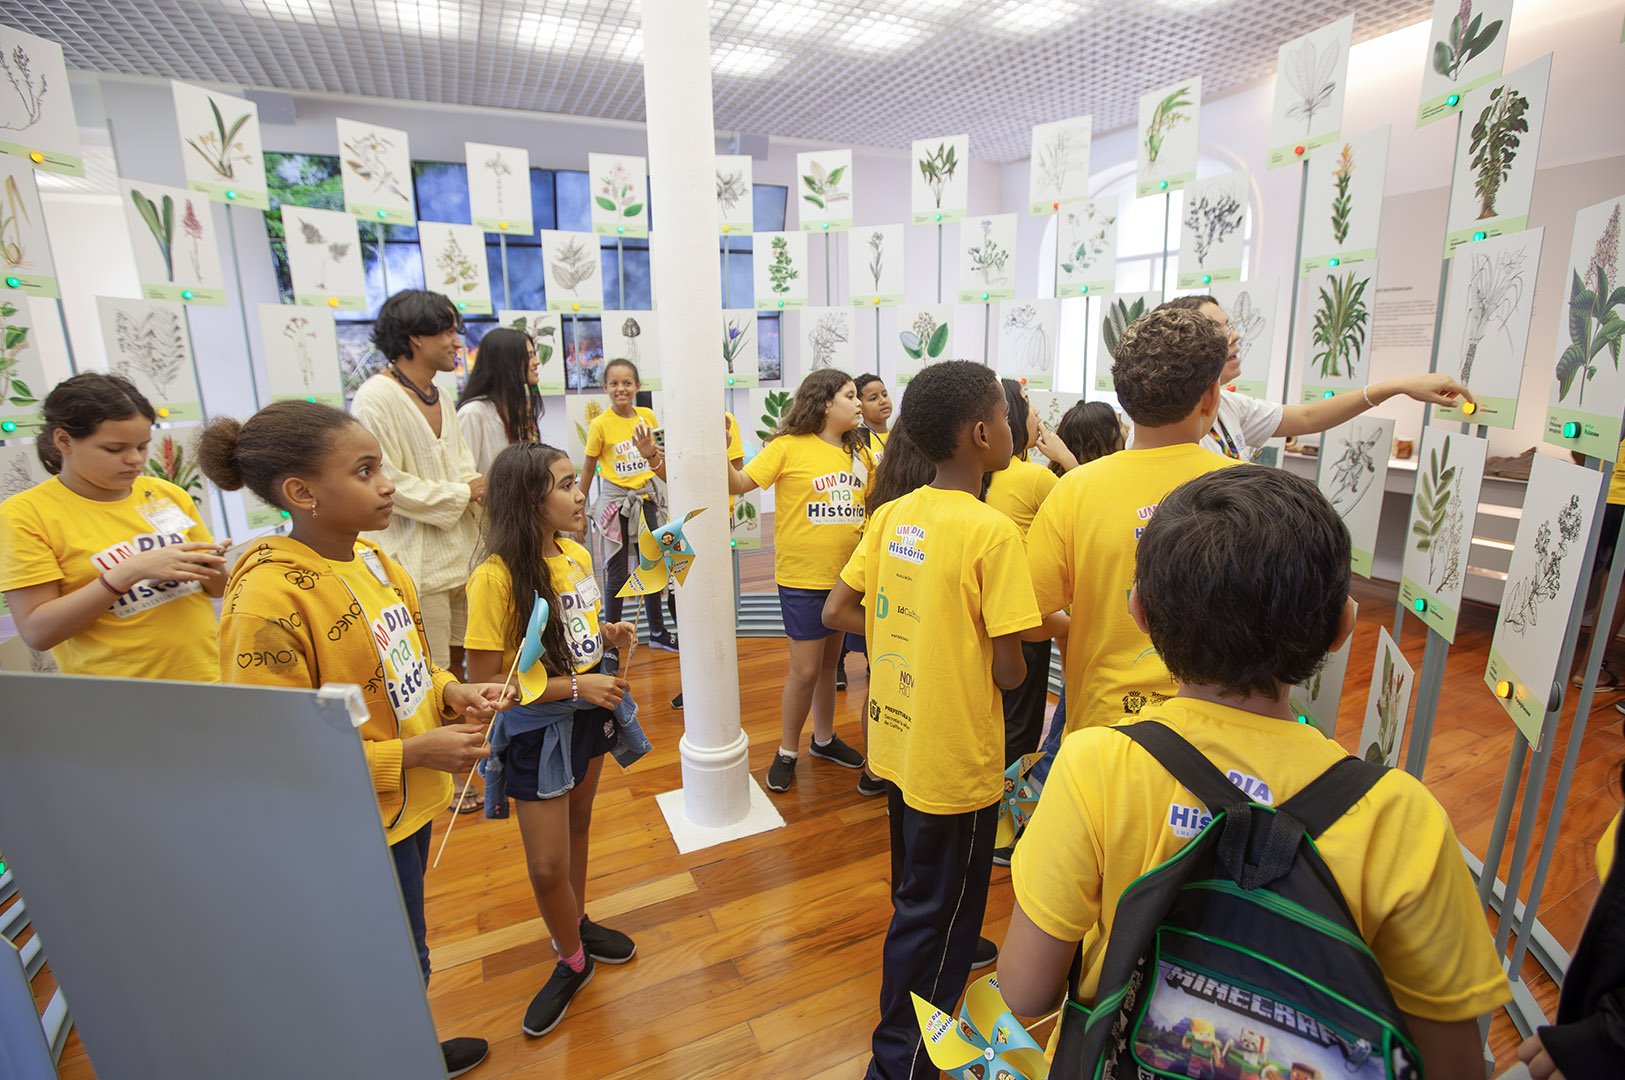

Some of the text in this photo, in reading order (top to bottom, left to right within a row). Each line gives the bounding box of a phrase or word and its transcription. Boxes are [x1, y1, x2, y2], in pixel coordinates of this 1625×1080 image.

[615, 459, 647, 472] Histór
[815, 473, 861, 491] UM DIA
[832, 489, 851, 501] na
[808, 503, 864, 517] História
[897, 526, 925, 539] UM DIA
[902, 536, 915, 546] na
[889, 541, 925, 561] História
[562, 594, 593, 610] DI
[336, 600, 362, 632] OVE
[374, 606, 412, 652] M DIA
[390, 639, 412, 673] na
[363, 664, 385, 694] OVE
[388, 661, 423, 708] istó
[900, 670, 915, 689] NOV
[1229, 771, 1270, 801] DIA
[932, 1010, 942, 1021] DIA
[1165, 966, 1353, 1060] MINECRAF
[931, 1016, 954, 1043] História
